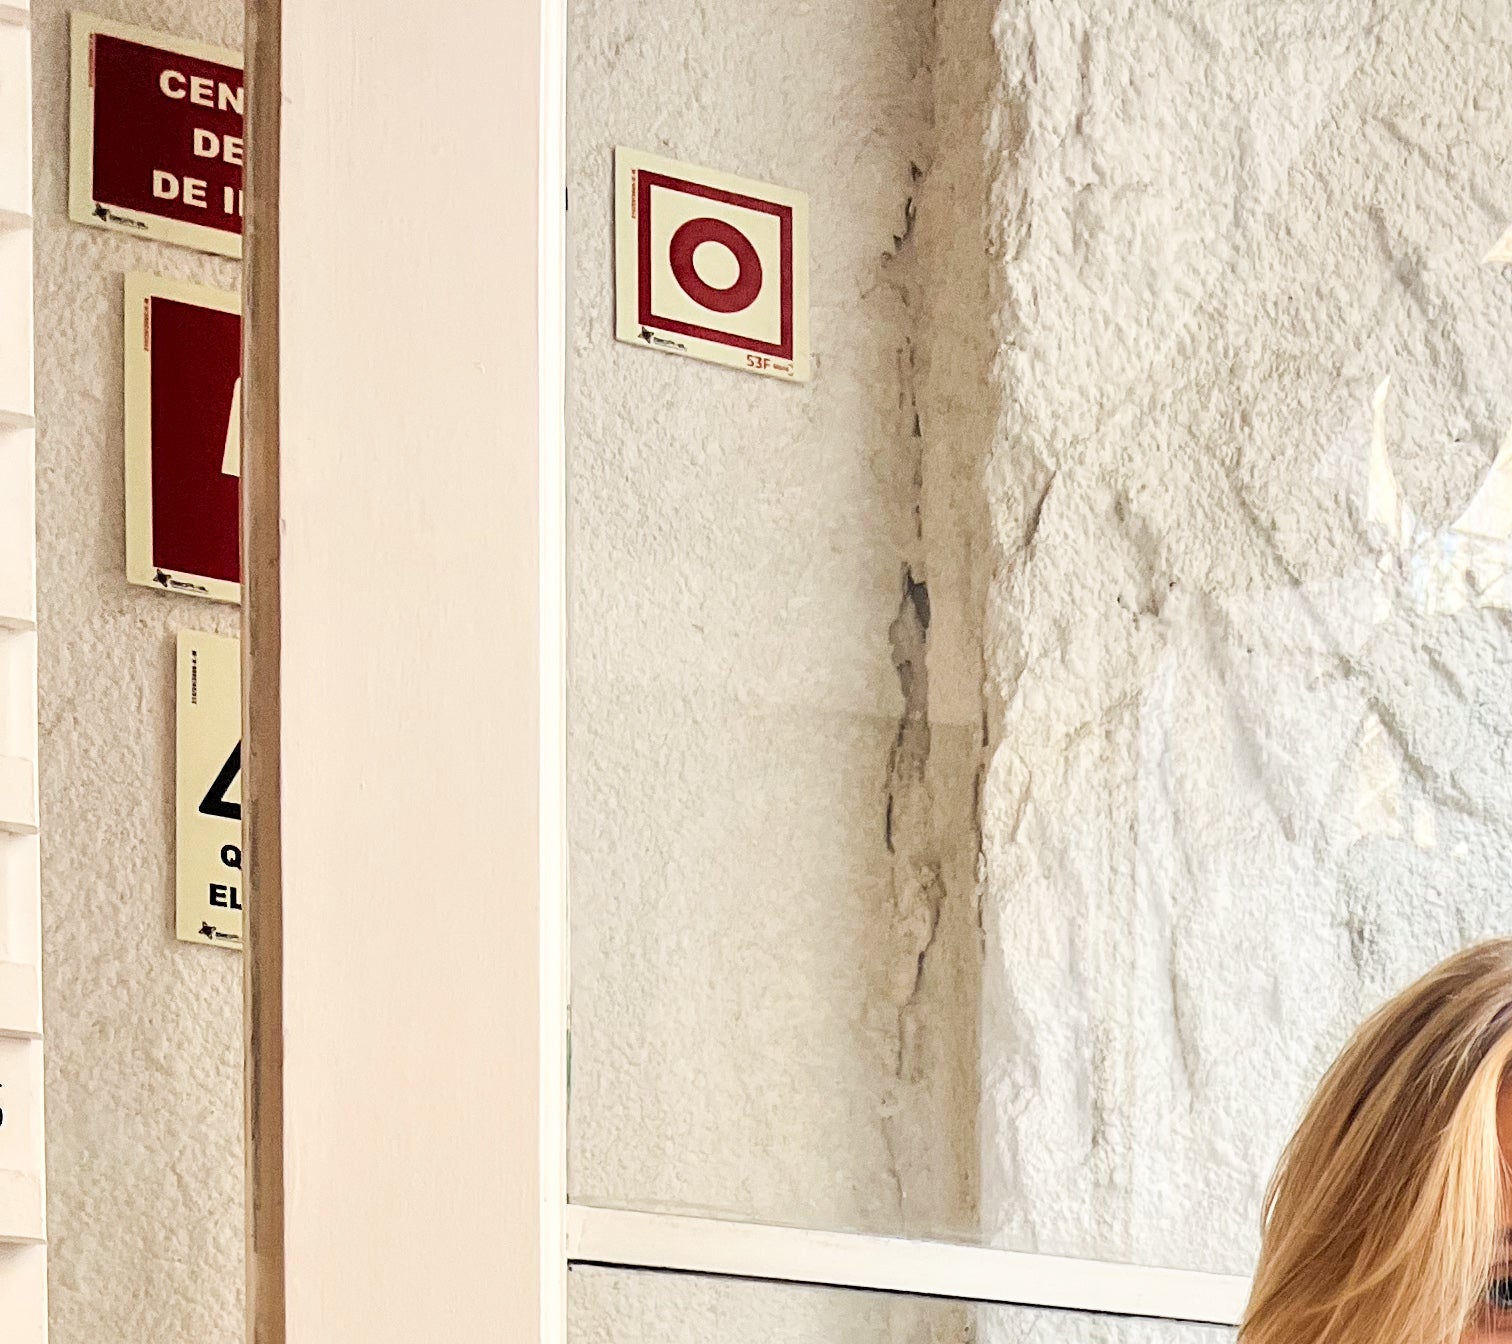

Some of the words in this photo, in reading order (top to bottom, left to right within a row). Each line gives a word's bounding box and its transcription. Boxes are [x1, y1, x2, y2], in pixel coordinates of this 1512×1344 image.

[159, 69, 244, 115] CEN
[193, 127, 244, 166] DE
[152, 168, 208, 209] DE
[220, 844, 243, 870] Q
[209, 883, 243, 911] EL
